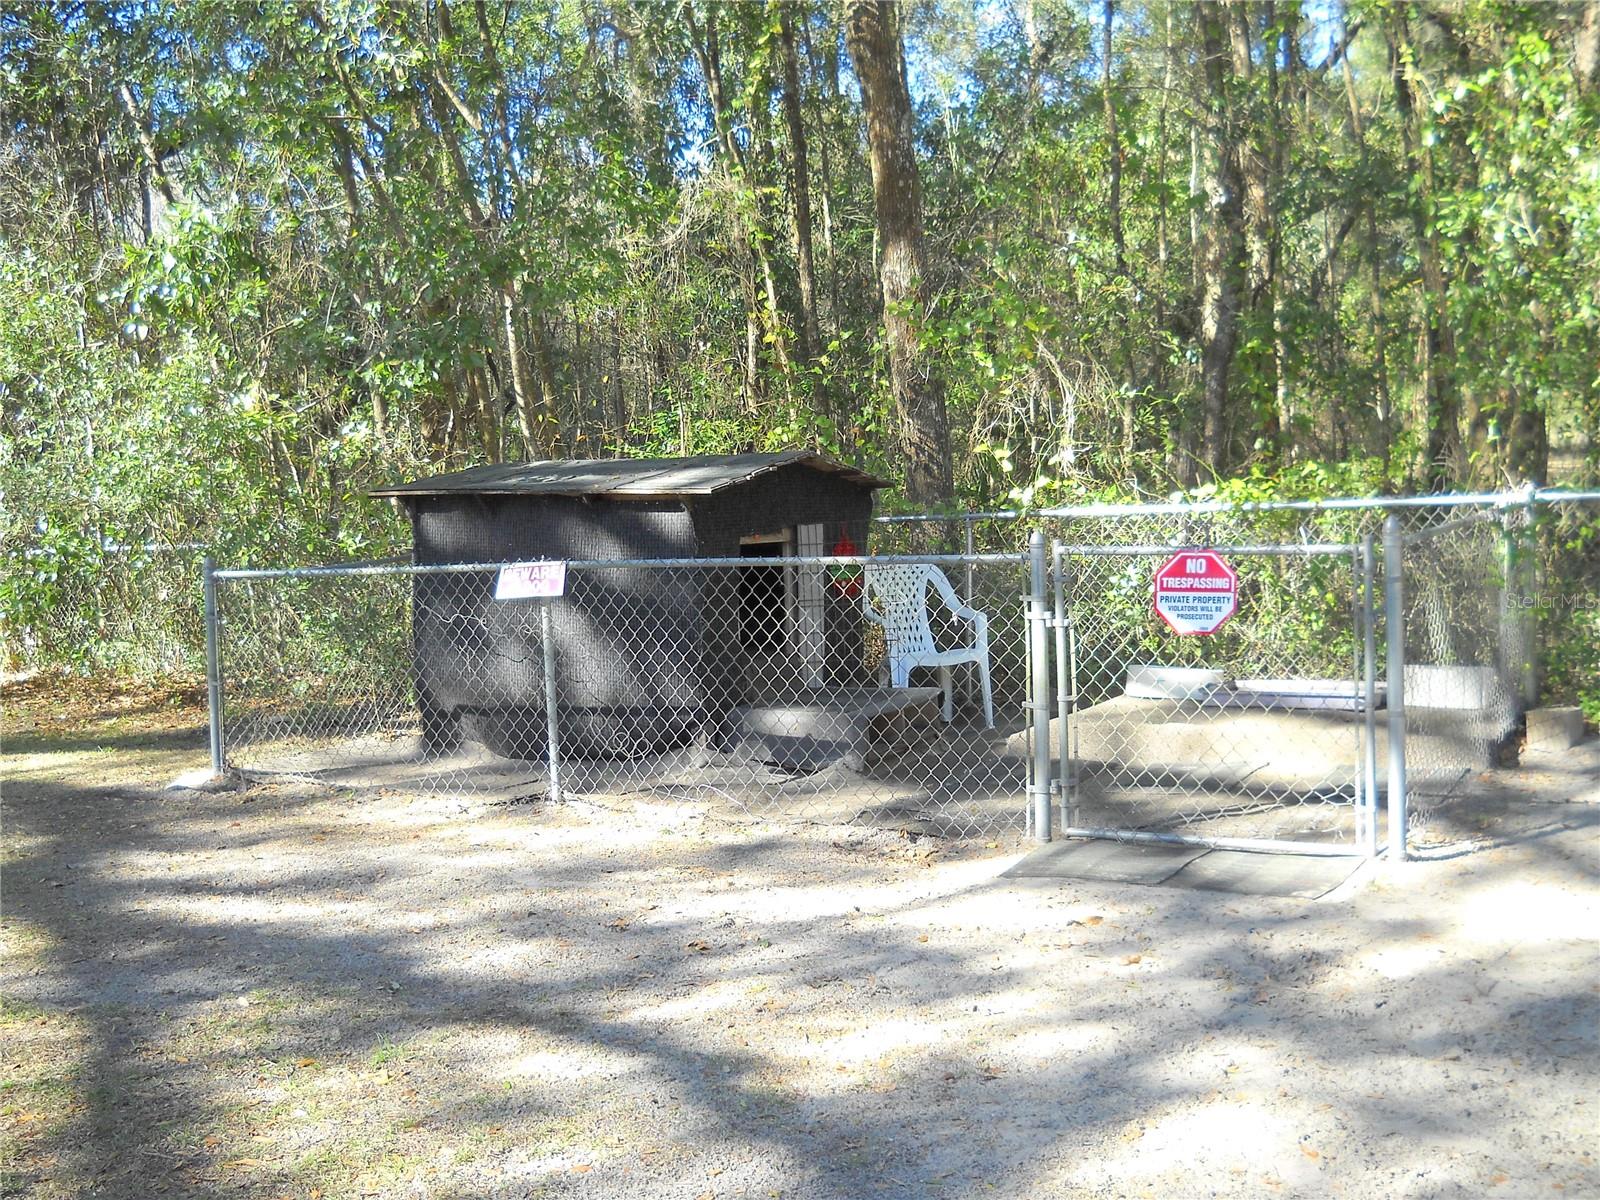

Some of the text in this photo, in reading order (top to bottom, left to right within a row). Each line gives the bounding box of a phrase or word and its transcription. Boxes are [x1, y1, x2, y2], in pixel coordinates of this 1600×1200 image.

[1185, 558, 1206, 574] NO
[1161, 577, 1230, 588] TRESPASSING
[1160, 596, 1231, 604] PRIVATE PROPERTY
